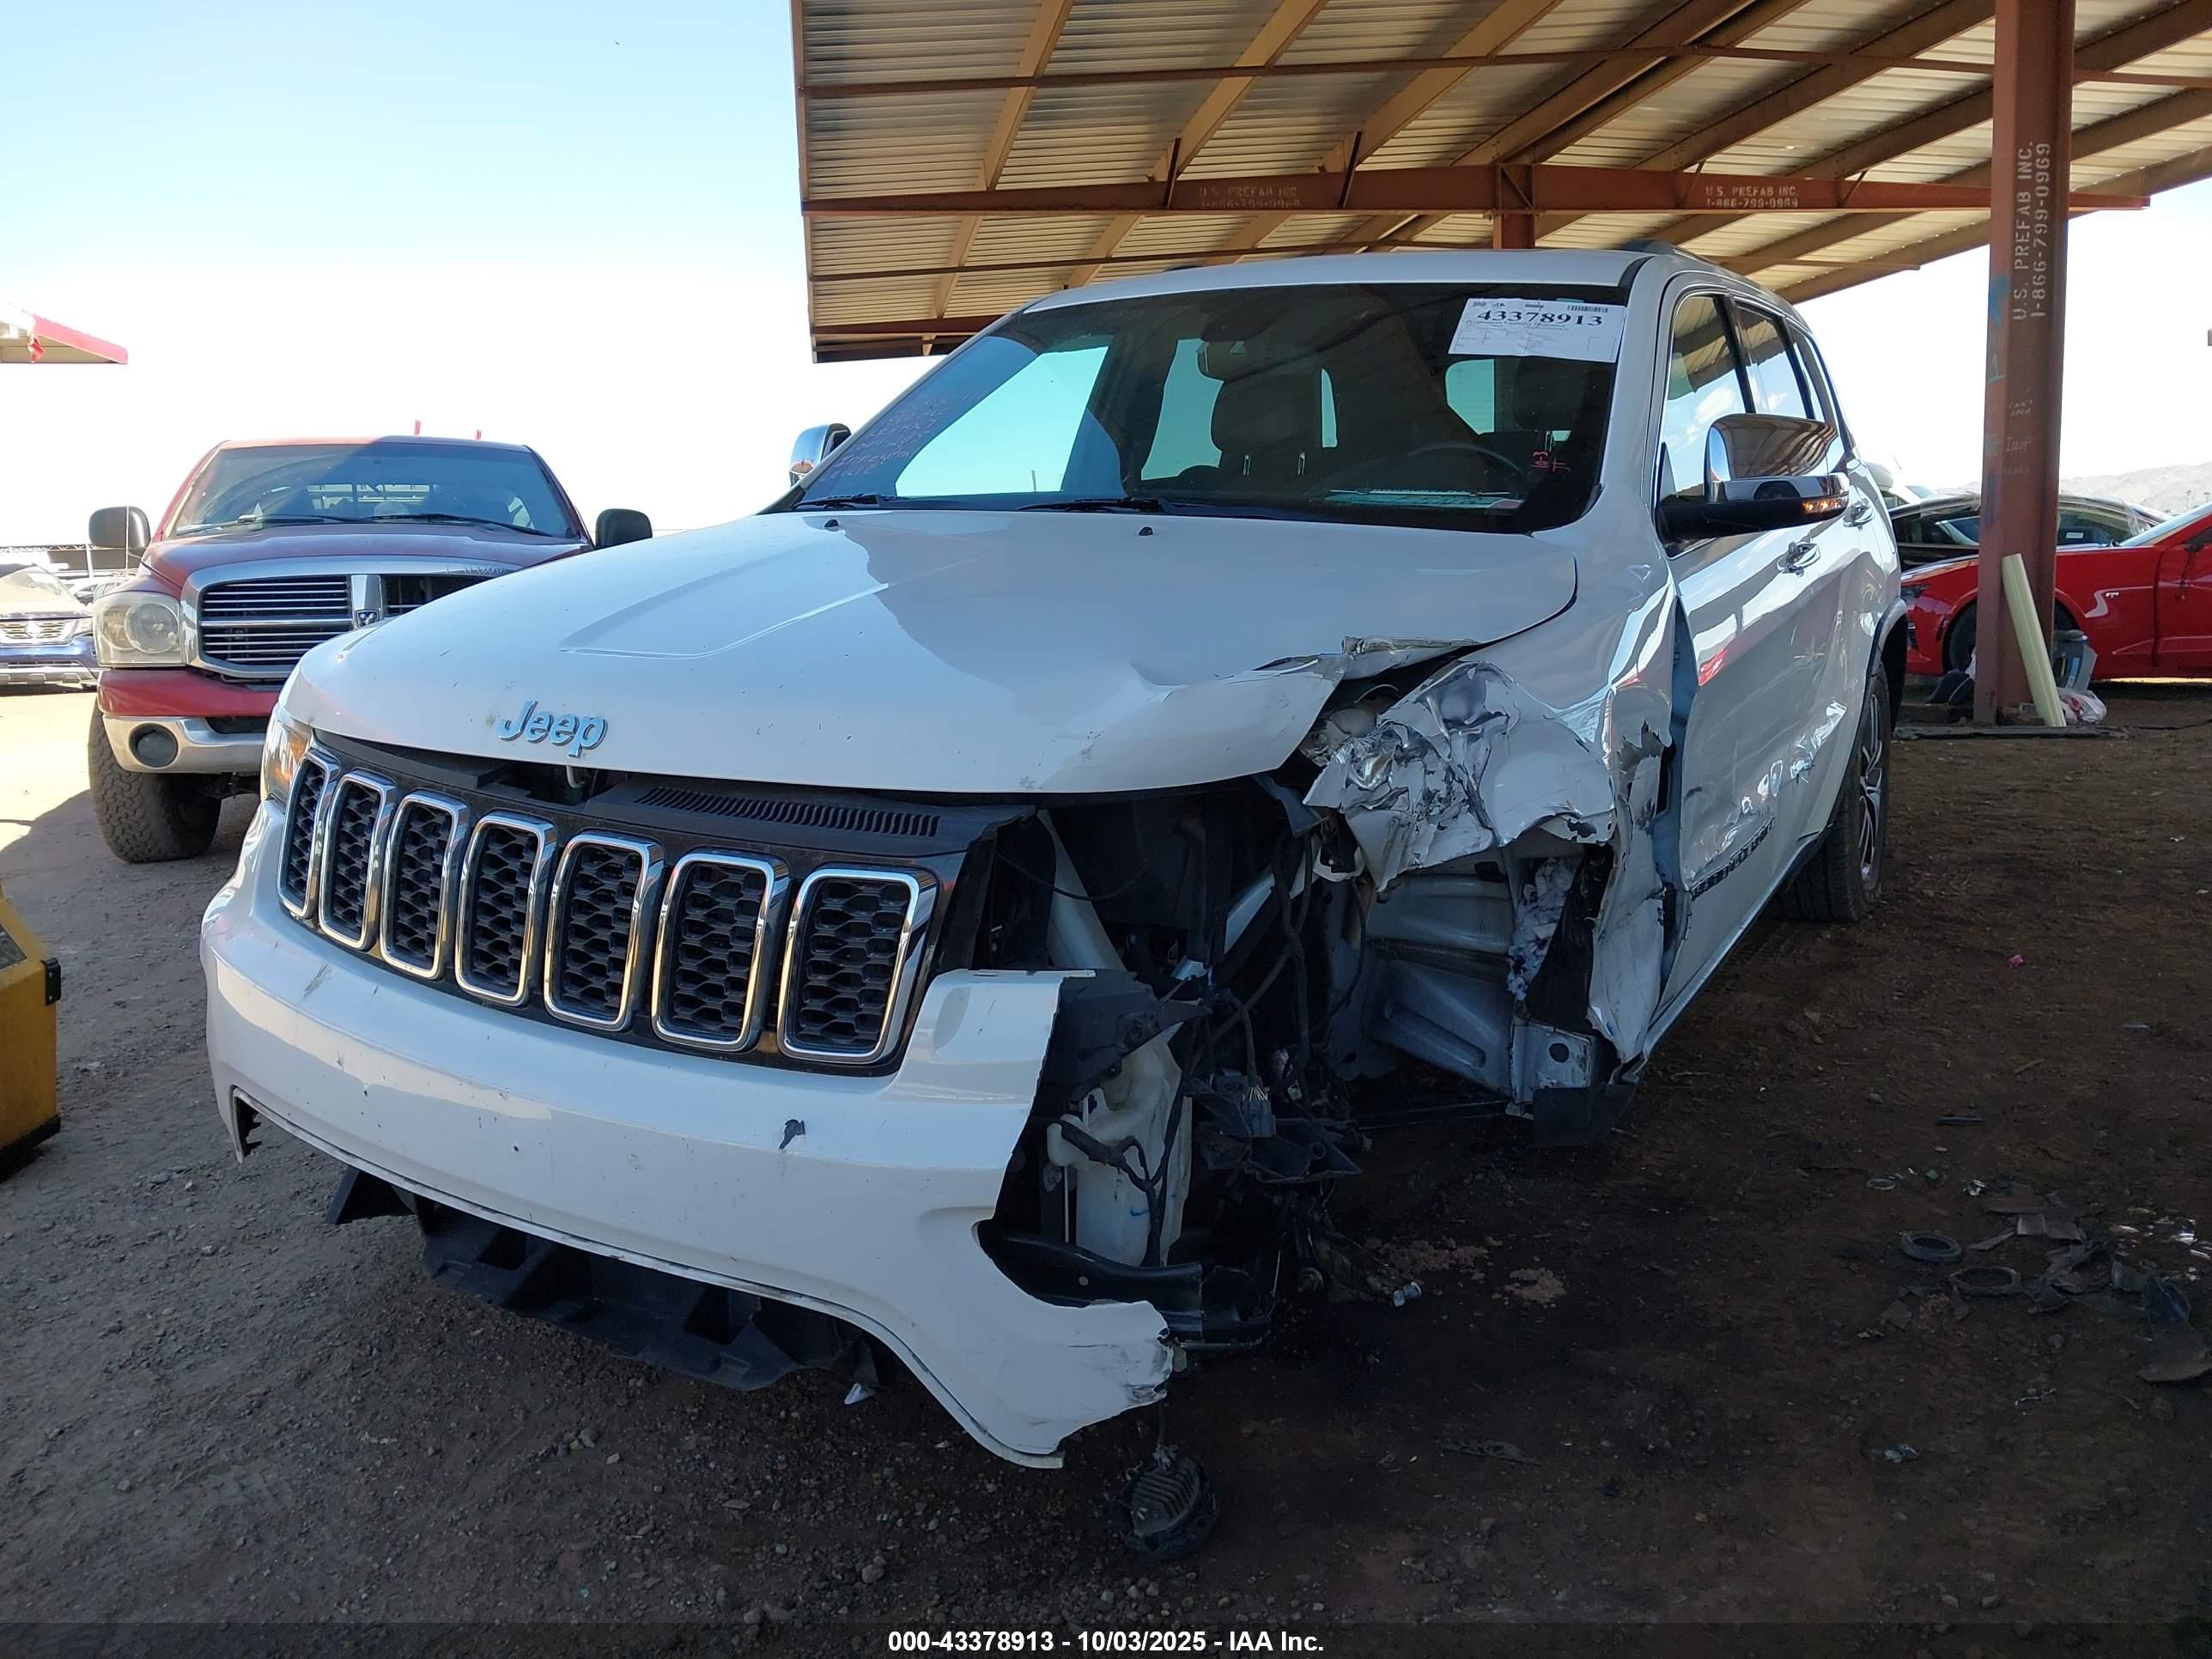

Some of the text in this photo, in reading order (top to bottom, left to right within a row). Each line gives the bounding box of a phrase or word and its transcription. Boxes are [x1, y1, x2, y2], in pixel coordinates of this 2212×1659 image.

[1732, 186, 1774, 197] PREFAB
[2013, 142, 2033, 320] U.S. PREFAB INC.
[2030, 143, 2051, 317] 1-866-799-0969
[1477, 309, 1602, 326] 43378913
[495, 700, 608, 758] Jeep
